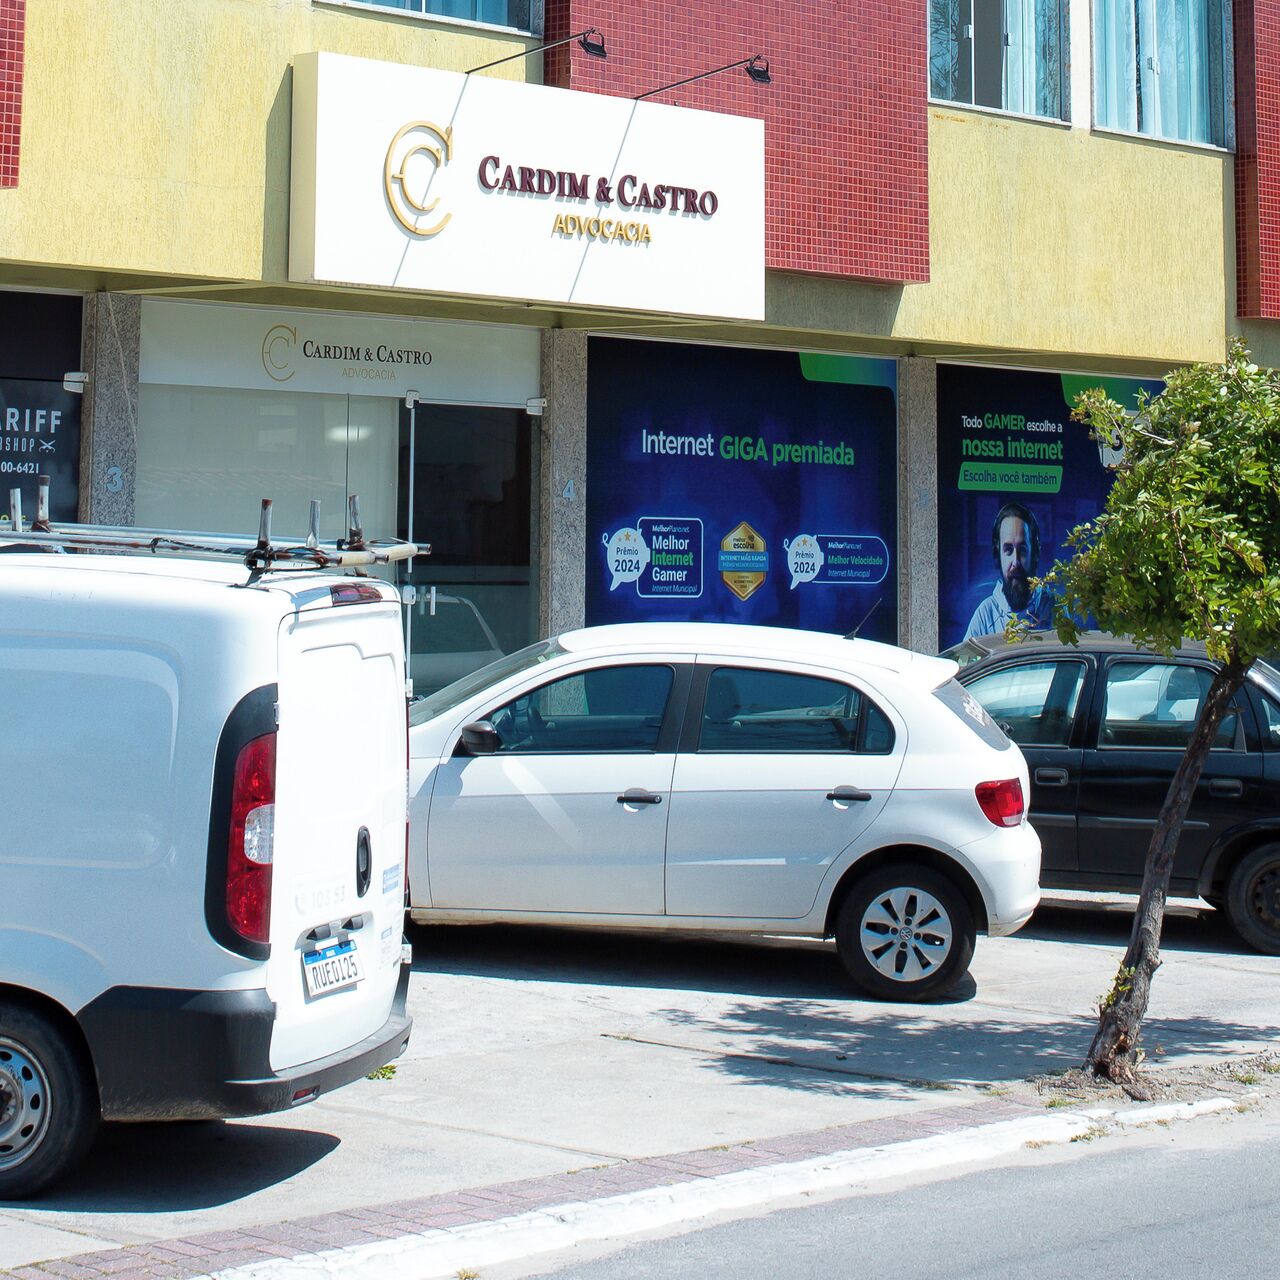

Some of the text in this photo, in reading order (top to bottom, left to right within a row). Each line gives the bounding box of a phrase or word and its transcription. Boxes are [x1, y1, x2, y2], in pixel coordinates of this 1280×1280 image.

[478, 155, 719, 217] CARDIM & CASTRO
[552, 213, 653, 243] ADVOCACIA
[302, 340, 433, 366] CARDIM & CASTRO
[341, 367, 397, 381] ADVOCACIA
[961, 412, 1063, 433] Todo GAMER escolhe a
[642, 428, 855, 466] Internet GIGA premiada
[962, 436, 1063, 460] nossa internet
[106, 466, 122, 493] 3
[963, 469, 1057, 485] Escolha você também
[562, 479, 576, 499] 4
[652, 535, 690, 550] Melhor
[616, 546, 638, 556] Prêmio
[795, 551, 814, 559] Prêmio
[615, 560, 640, 572] 2024
[652, 552, 694, 566] Internet
[828, 555, 882, 565] Melhor Velocidade
[652, 567, 688, 582] Gamer
[794, 562, 816, 573] 2024
[847, 570, 870, 578] Municipal
[652, 584, 697, 594] Internet Municipal
